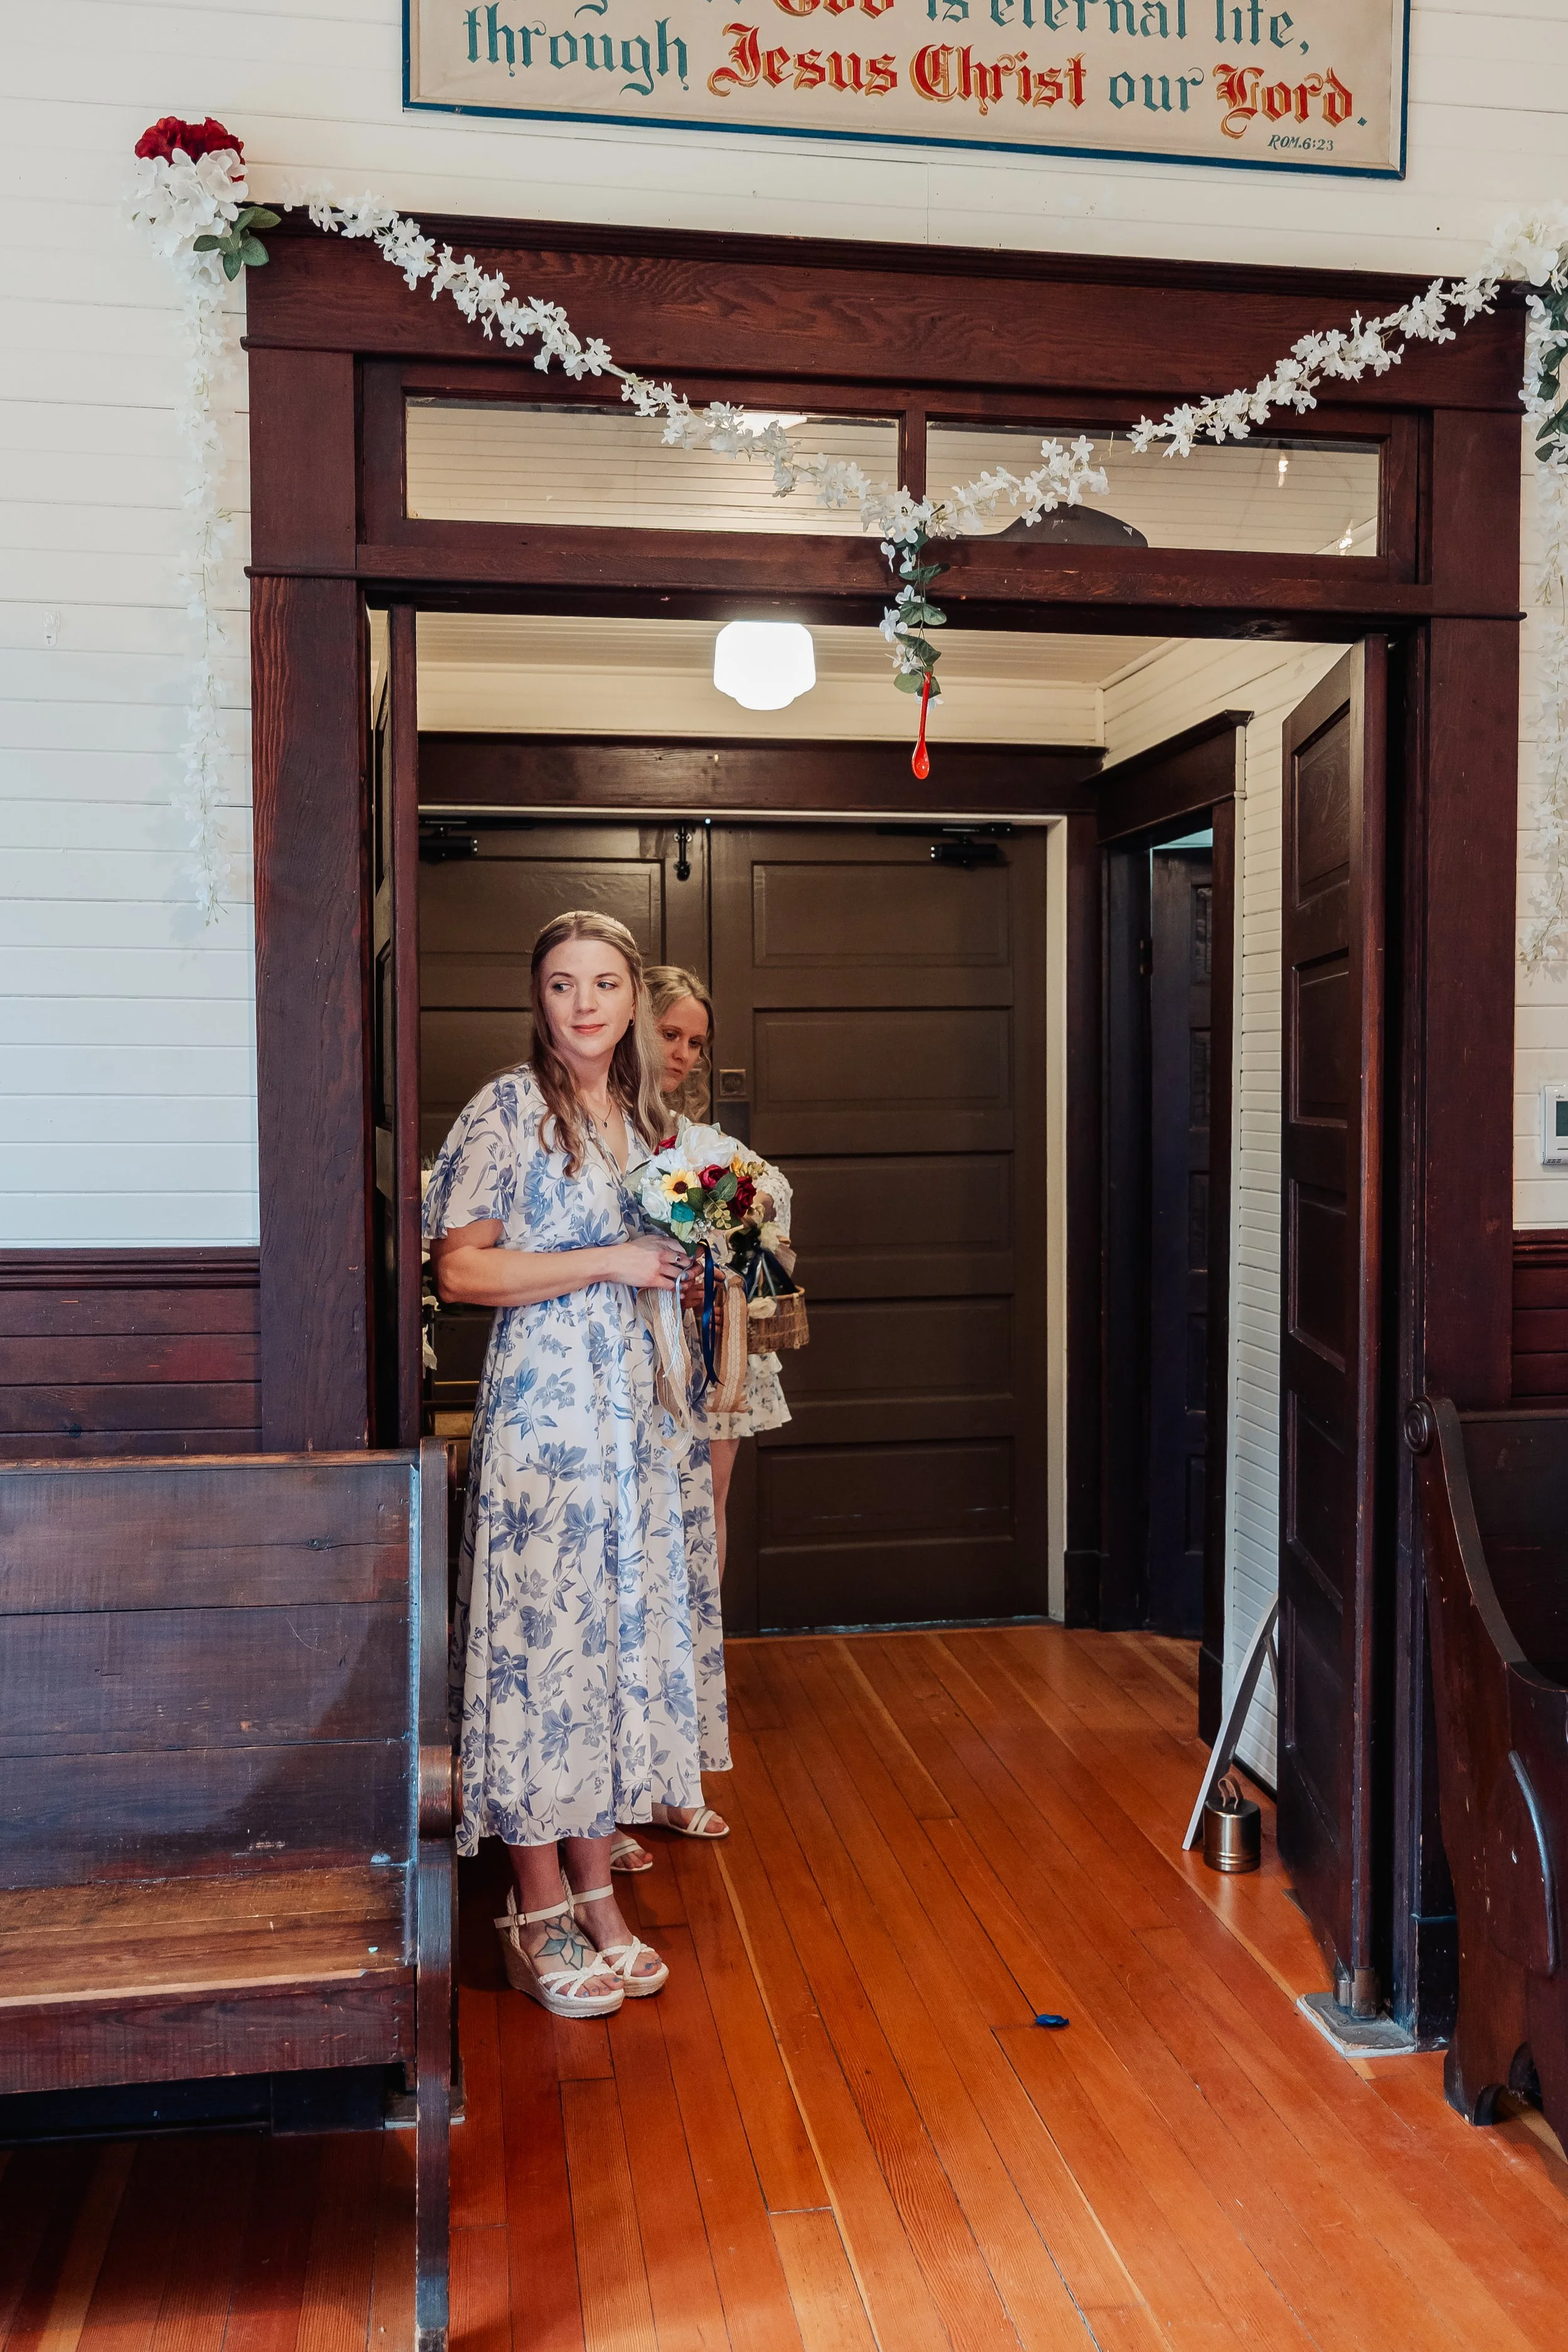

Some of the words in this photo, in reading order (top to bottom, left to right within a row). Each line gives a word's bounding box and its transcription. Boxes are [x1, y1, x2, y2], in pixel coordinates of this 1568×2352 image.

[462, 4, 690, 97] through
[707, 22, 899, 97] Jesus
[909, 43, 1088, 116] Christ
[1108, 66, 1205, 113] our
[1212, 61, 1368, 139] Lord.
